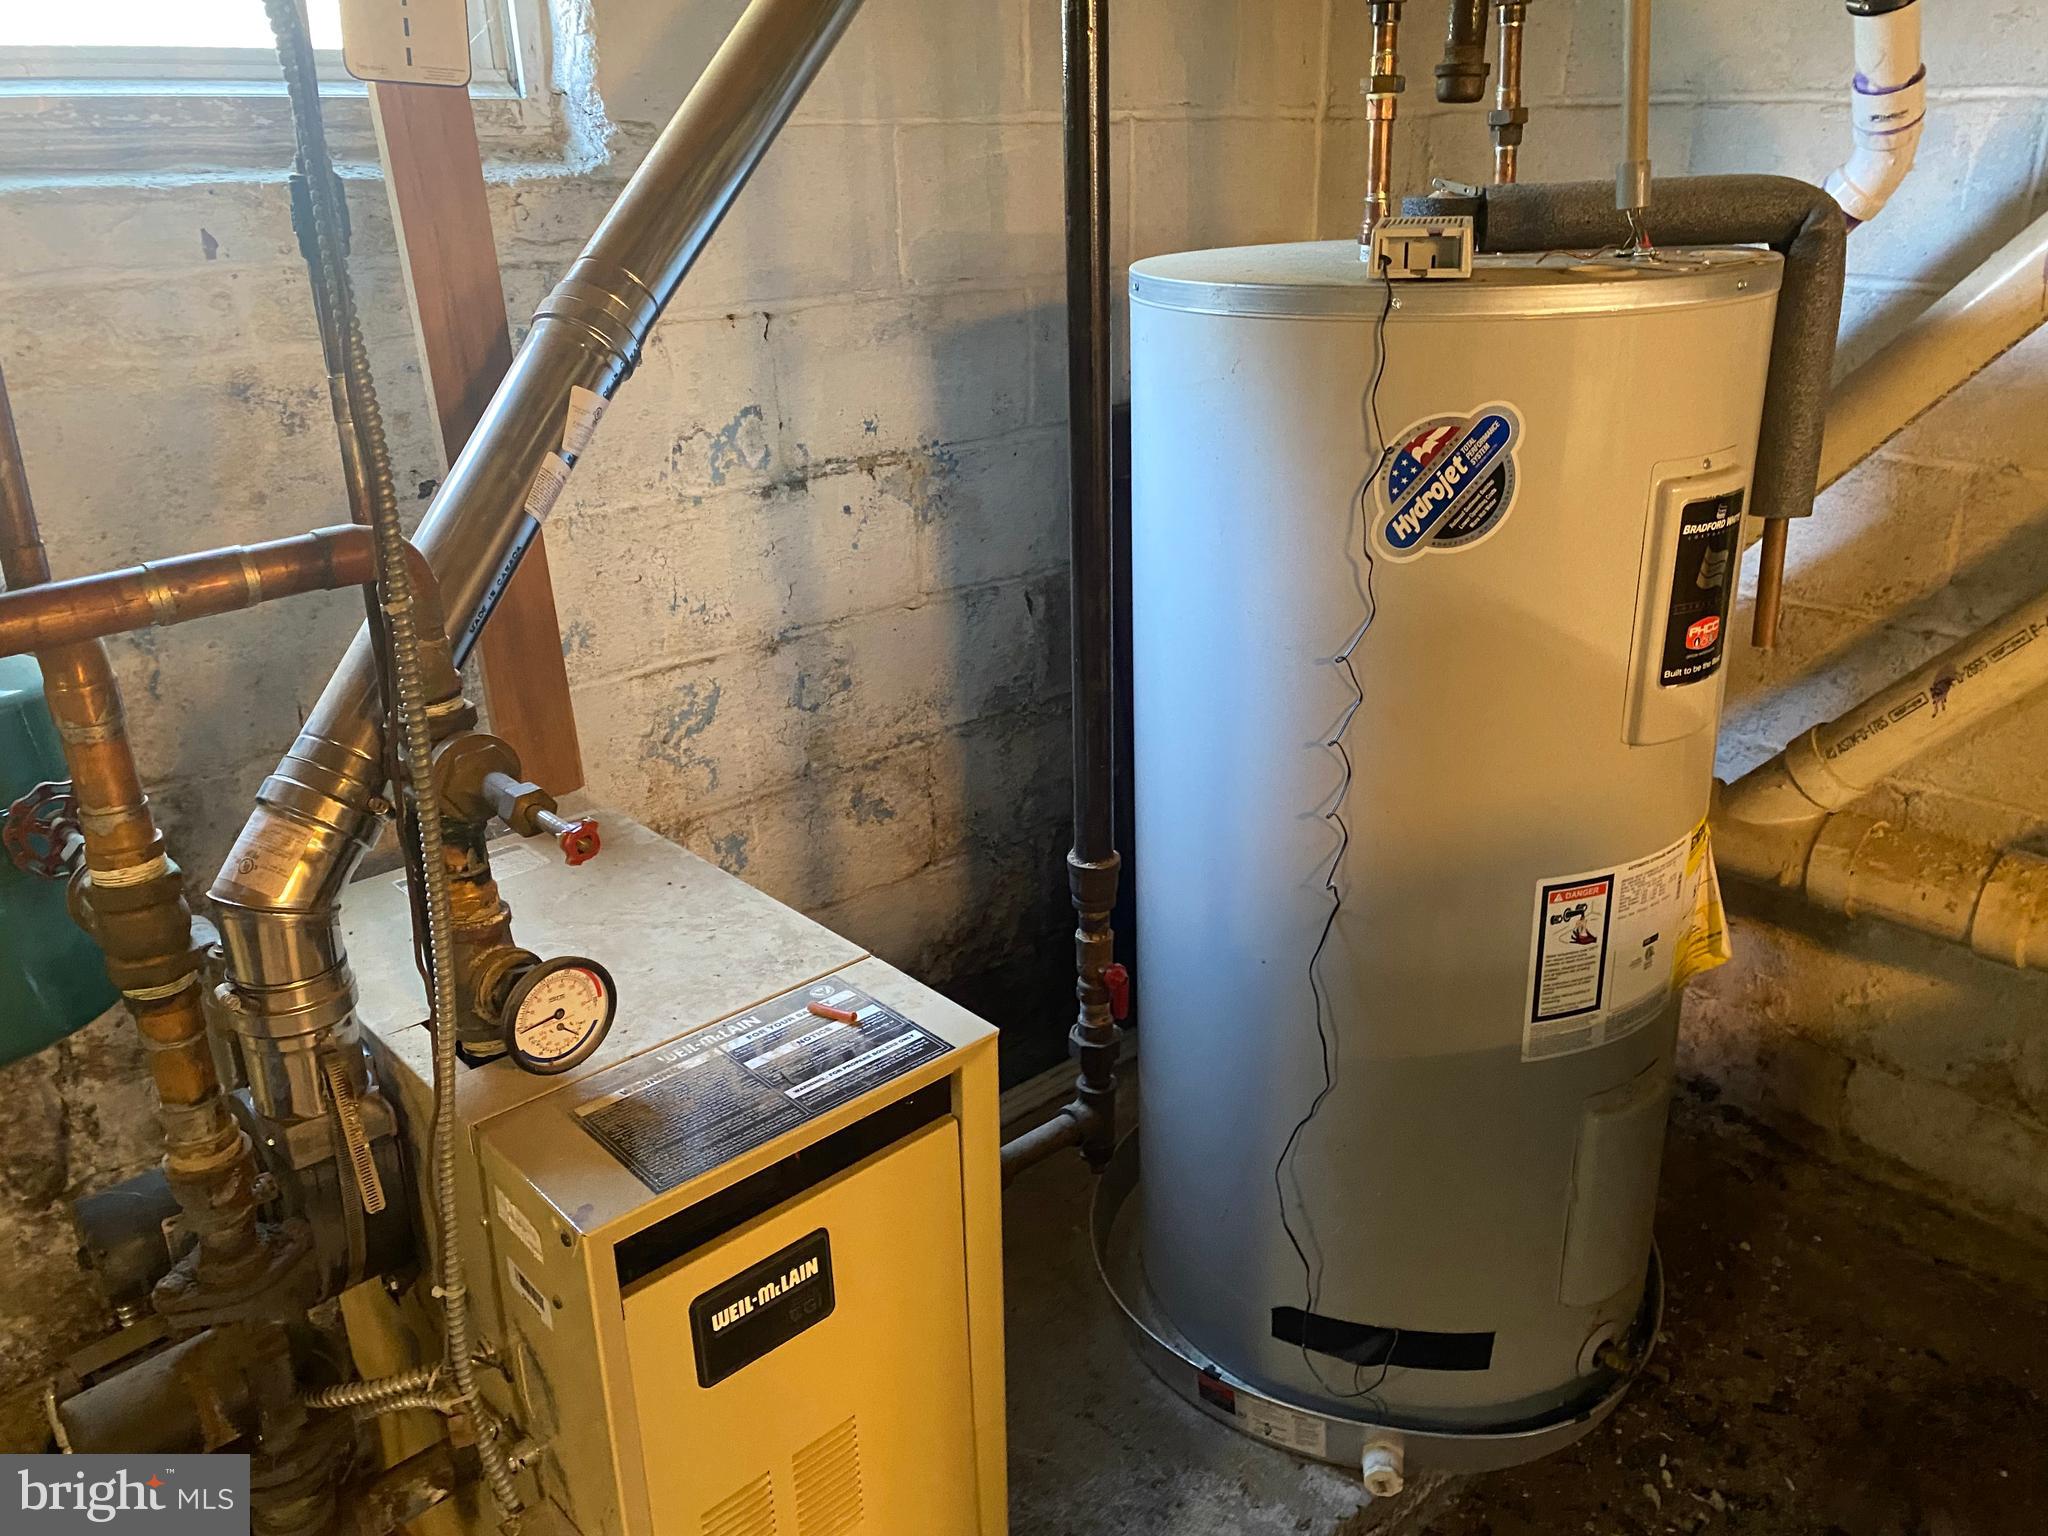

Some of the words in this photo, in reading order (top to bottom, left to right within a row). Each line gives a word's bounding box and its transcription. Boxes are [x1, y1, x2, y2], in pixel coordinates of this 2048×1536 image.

[1460, 437, 1477, 454] TOTAL
[1466, 420, 1500, 460] PERFORMANCE
[1470, 444, 1490, 466] SYSTEM
[1393, 456, 1468, 540] Hydrojet
[1683, 518, 1726, 535] BRADFORD
[1689, 620, 1720, 638] PHCC
[1664, 665, 1682, 679] Built
[1684, 666, 1692, 676] to
[1693, 662, 1702, 672] be
[1565, 886, 1600, 900] DANGER
[746, 1027, 766, 1041] FOR
[766, 1014, 795, 1032] YOUR
[796, 1026, 834, 1048] NOTICE
[898, 1033, 914, 1044] ONLY
